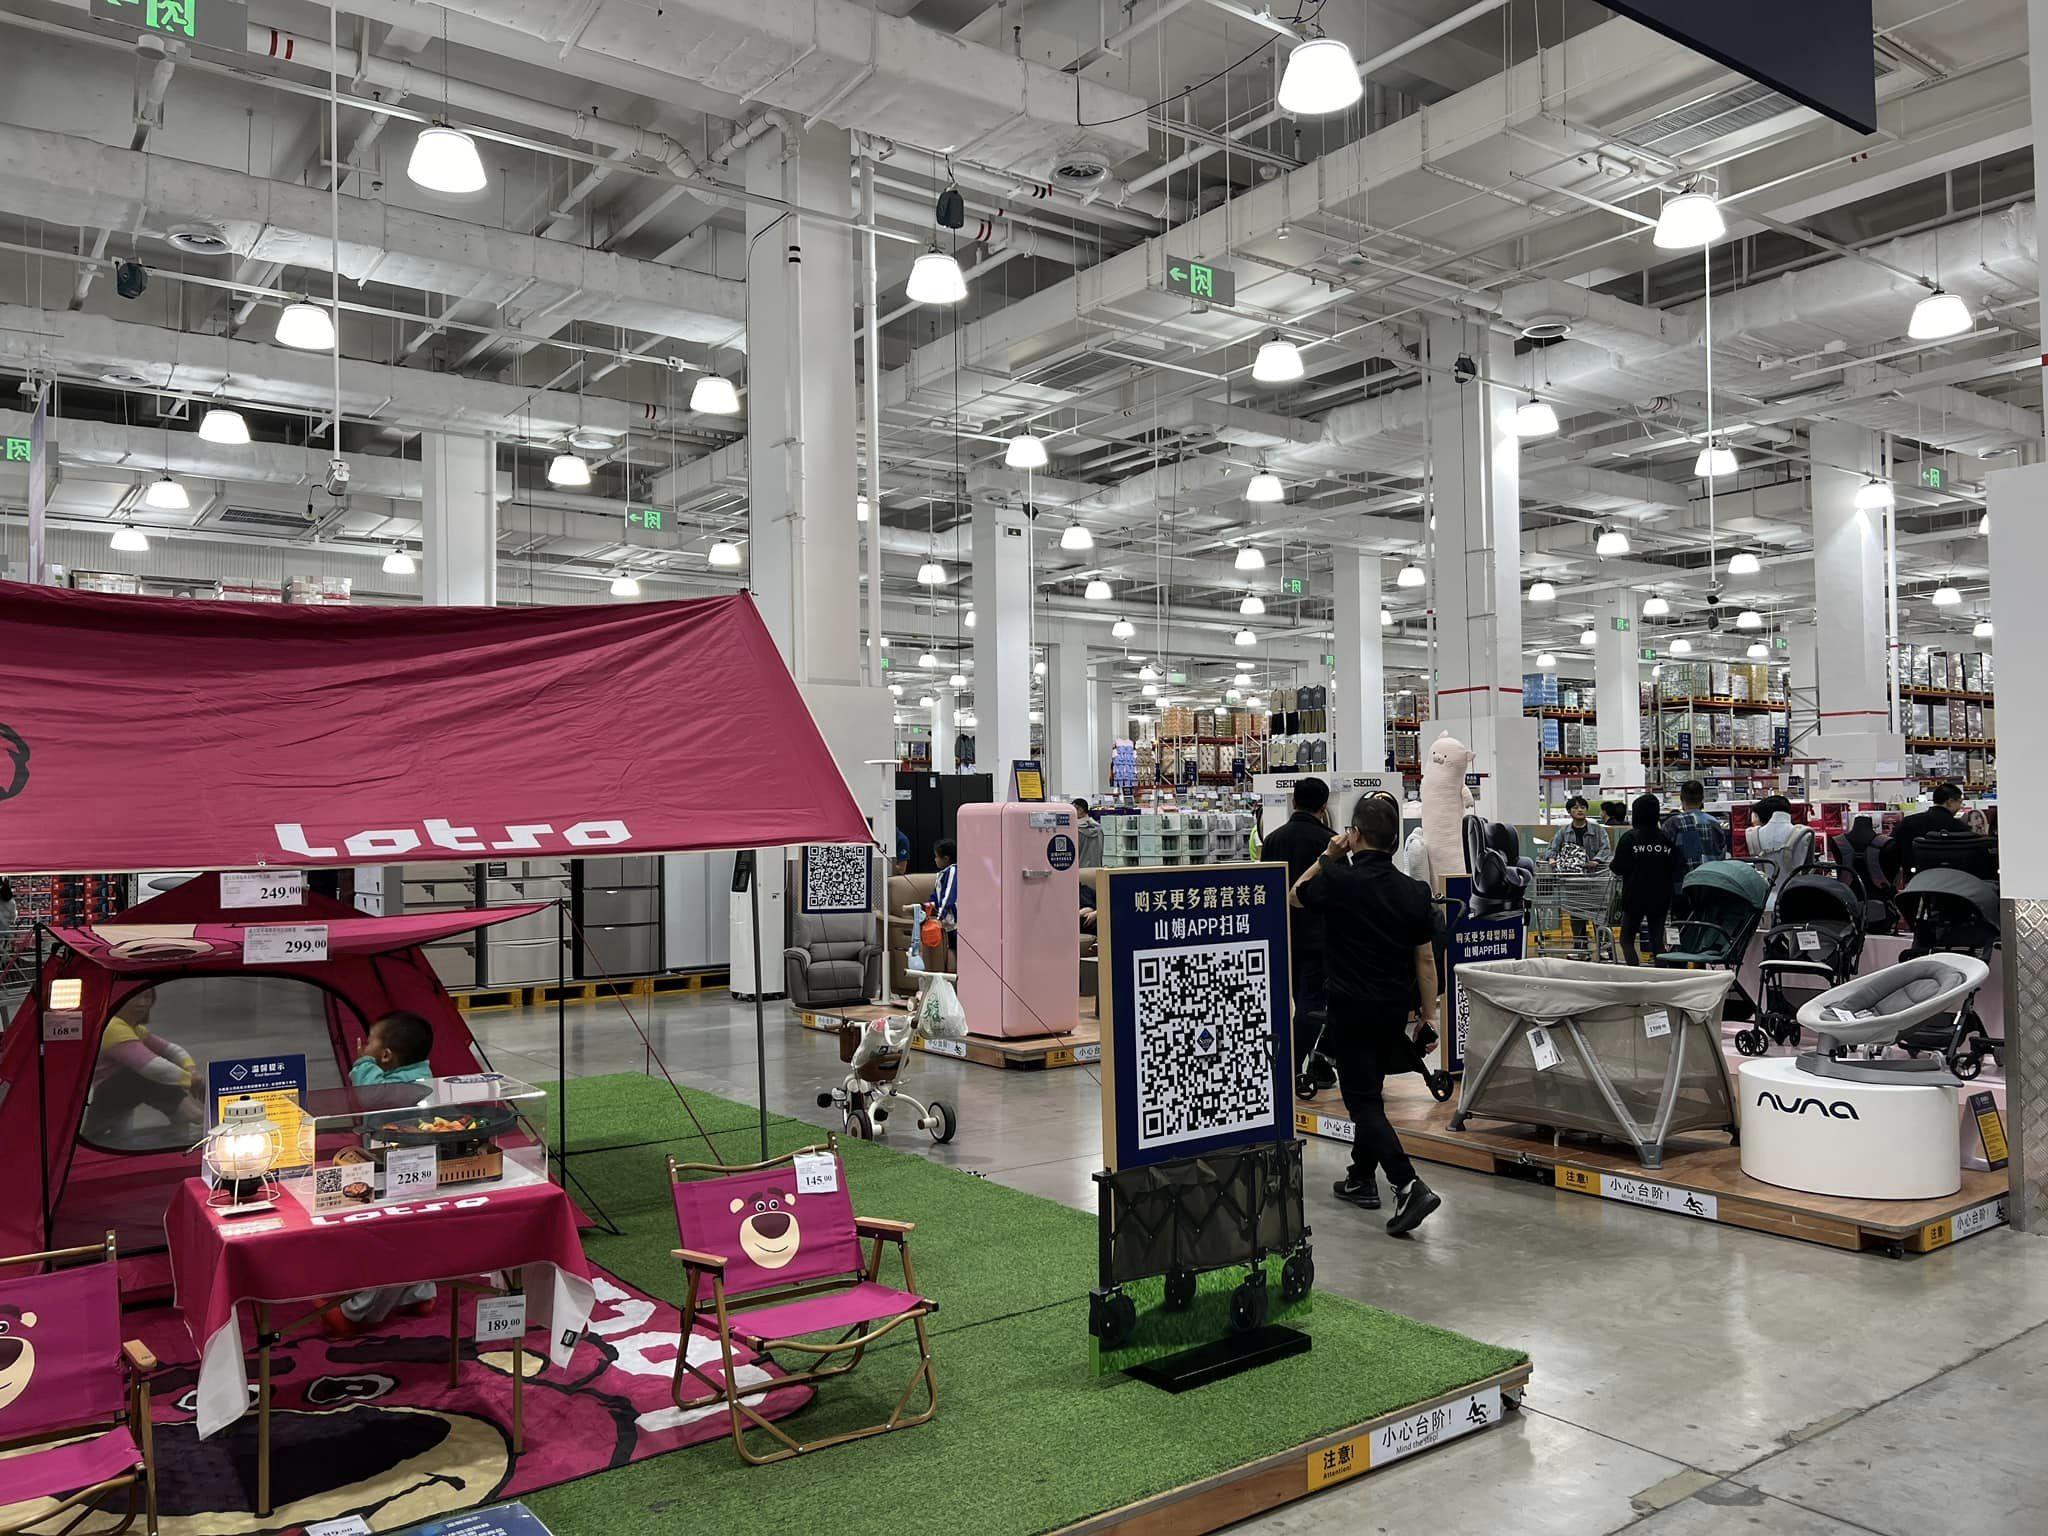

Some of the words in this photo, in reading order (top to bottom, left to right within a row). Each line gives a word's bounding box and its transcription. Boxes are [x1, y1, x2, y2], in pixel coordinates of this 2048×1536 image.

[1353, 778, 1382, 788] SEIKO
[273, 818, 633, 858] Lotso
[260, 886, 301, 900] 249.00
[1134, 883, 1267, 913] 购买更多露营装备
[1154, 913, 1250, 941] 山姆APP扫码
[284, 939, 327, 954] 299.00
[1464, 943, 1508, 958] 山姆APP扫码
[1757, 1091, 1860, 1121] nuna
[397, 1170, 431, 1184] 228.80
[806, 1175, 832, 1185] 145.00
[1610, 1178, 1670, 1202] 小心台阶!
[311, 1196, 490, 1227] Lotso
[487, 1318, 521, 1332] 189.00
[1382, 1408, 1453, 1448] 小心台阶!
[1396, 1441, 1413, 1455] Mind
[1413, 1438, 1424, 1451] the
[1323, 1444, 1355, 1471] 注意!
[1323, 1463, 1353, 1481] Attention!
